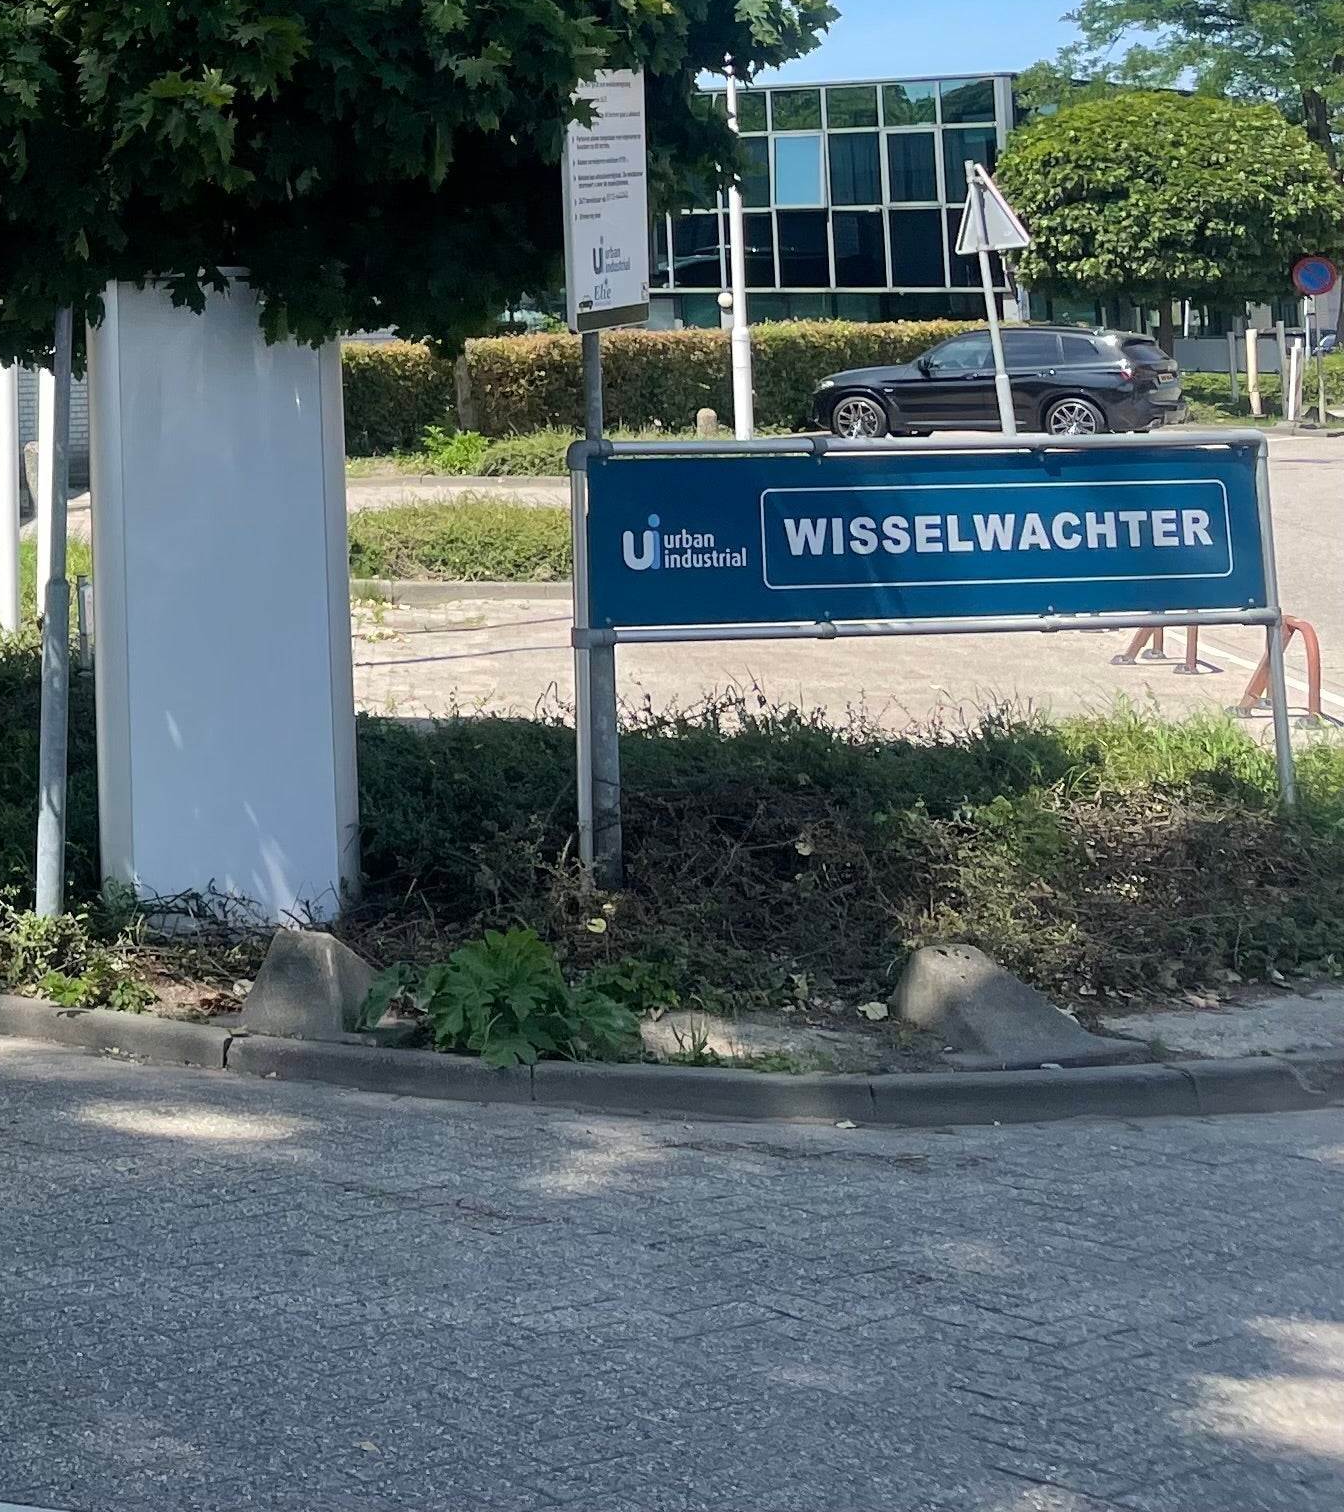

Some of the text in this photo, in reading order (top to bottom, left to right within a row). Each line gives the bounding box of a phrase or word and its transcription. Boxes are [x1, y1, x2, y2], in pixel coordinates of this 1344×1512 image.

[663, 528, 715, 549] urban
[783, 509, 1215, 556] WISSELWACHTER
[664, 547, 747, 569] industrial
